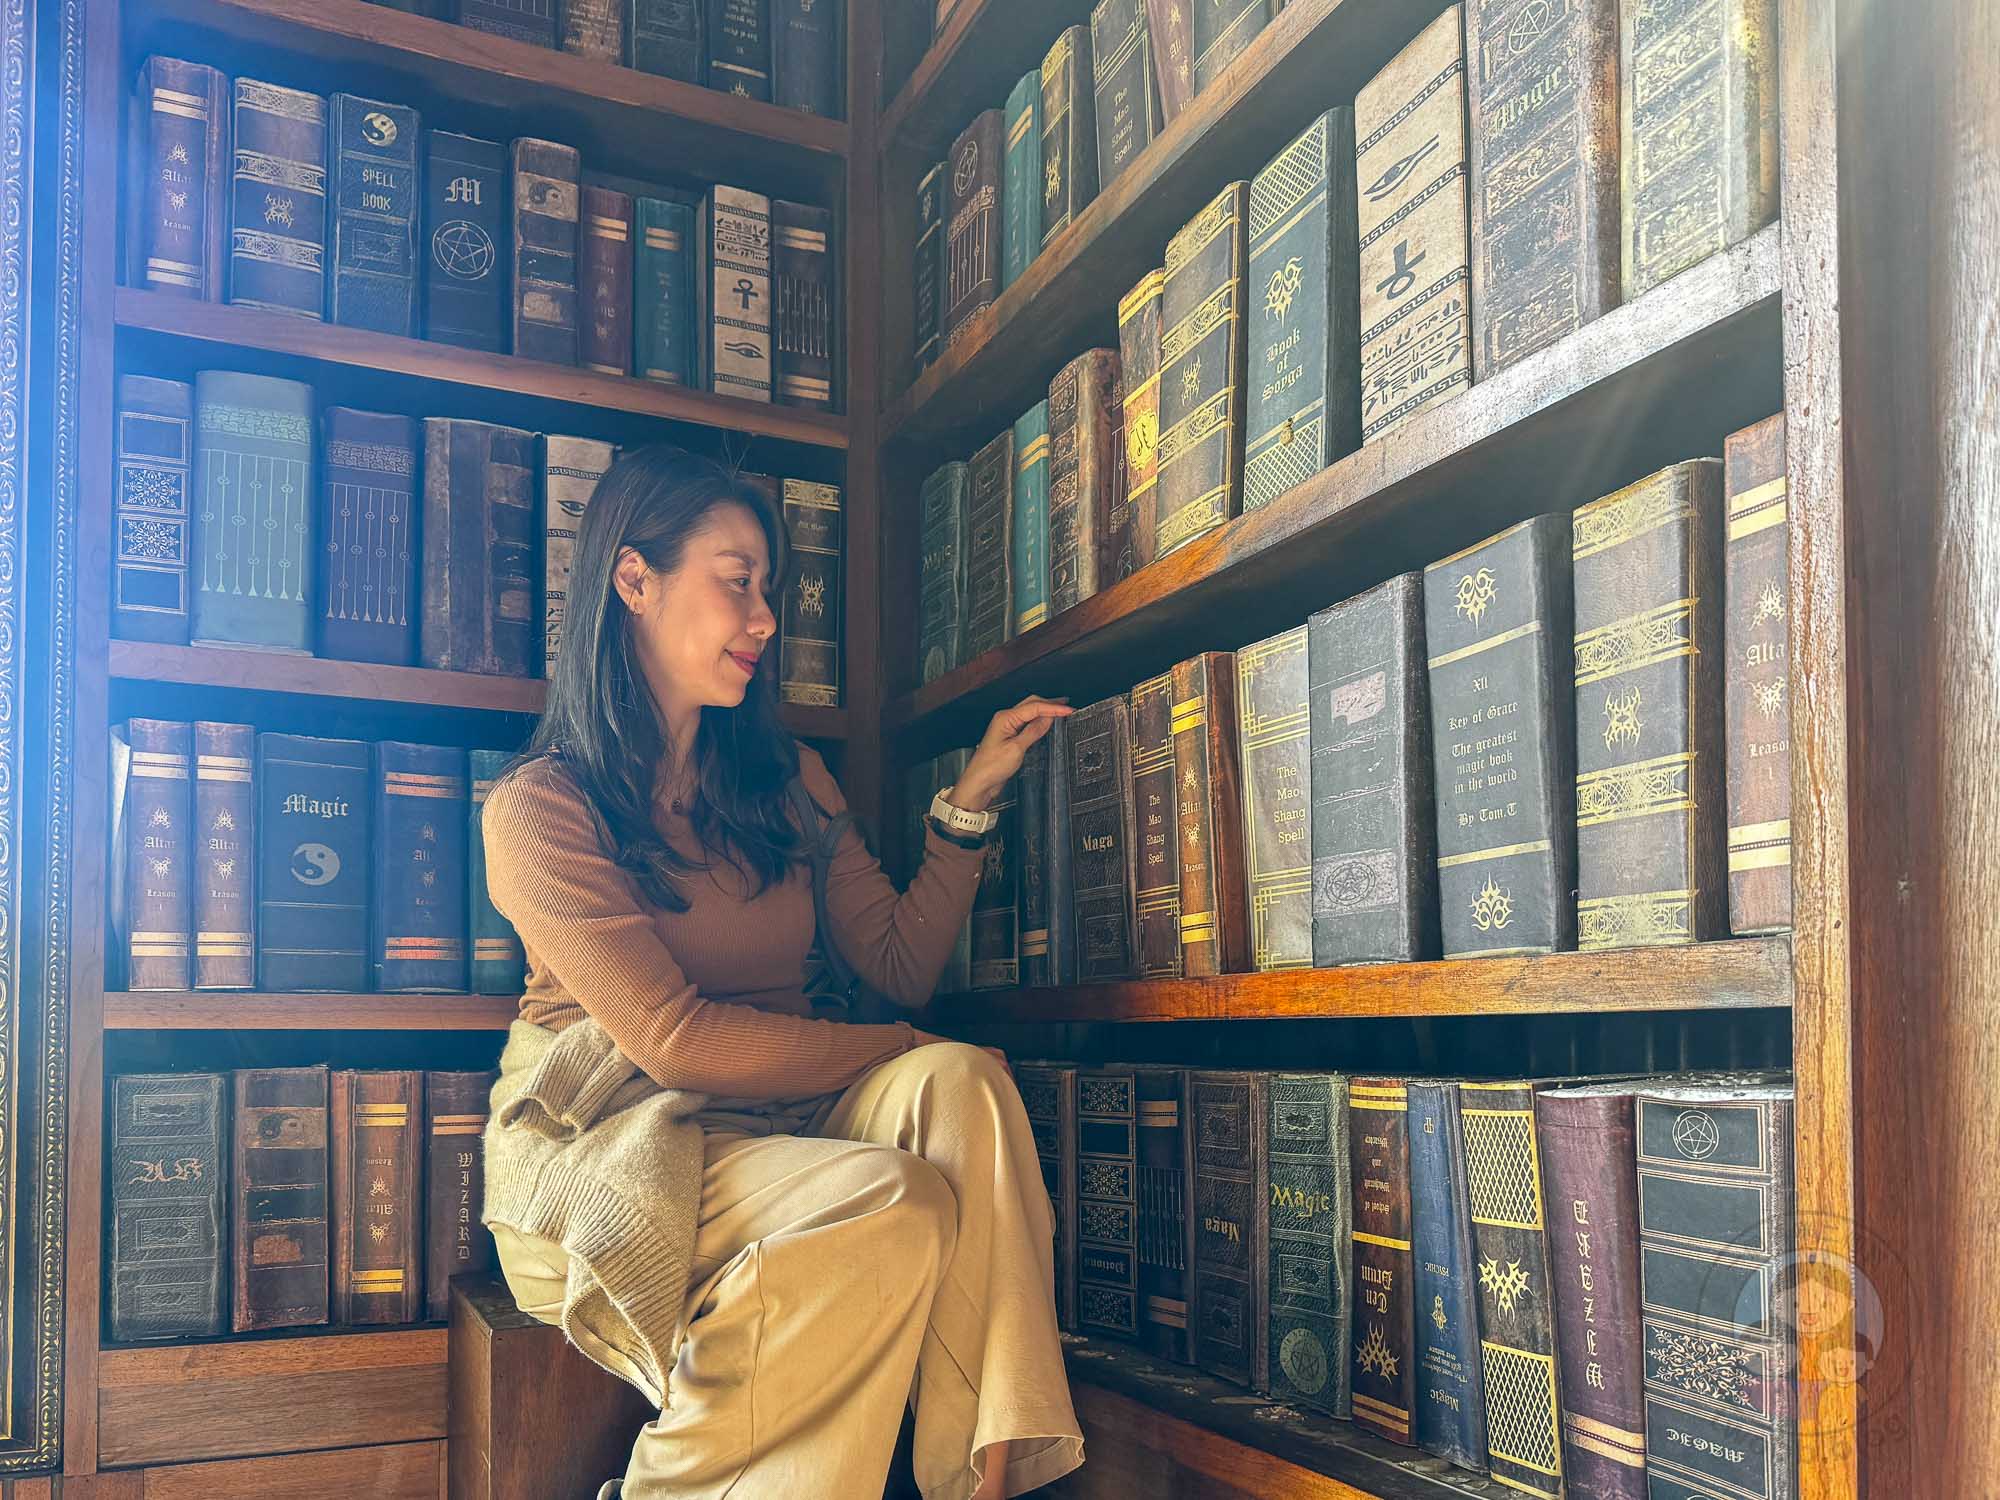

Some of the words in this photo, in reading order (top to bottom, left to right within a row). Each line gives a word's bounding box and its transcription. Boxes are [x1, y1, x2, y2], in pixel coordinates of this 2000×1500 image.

[362, 168, 397, 189] SPELL
[362, 191, 392, 211] BOOK
[1265, 328, 1301, 362] Book
[1277, 351, 1289, 374] of
[1746, 640, 1786, 668] Alta
[1447, 716, 1468, 731] Key
[1472, 708, 1483, 724] of
[1487, 701, 1518, 720] Grace
[1452, 743, 1472, 759] The
[1476, 729, 1517, 754] greatest
[1275, 766, 1297, 779] The
[1457, 759, 1485, 775] magic
[1489, 748, 1513, 767] book
[1455, 782, 1464, 794] in
[1468, 777, 1483, 793] the
[1488, 767, 1517, 787] world
[1149, 795, 1161, 807] The
[1277, 787, 1300, 801] Mao
[282, 793, 350, 819] Magic
[1273, 808, 1306, 823] Shang
[1148, 814, 1162, 826] Mao
[1456, 812, 1474, 829] By
[1082, 834, 1114, 852] Maga
[1146, 833, 1165, 846] Shang
[1278, 827, 1305, 844] Spell
[1148, 852, 1164, 866] Spell
[457, 1152, 474, 1260] WIZARD
[1270, 1183, 1330, 1218] Magic
[1205, 1216, 1240, 1242] Maga
[1425, 1261, 1450, 1277] PSYCHIC
[1366, 1289, 1388, 1314] Ten
[1430, 1389, 1459, 1412] Magic
[1666, 1428, 1746, 1463] MAGIC
